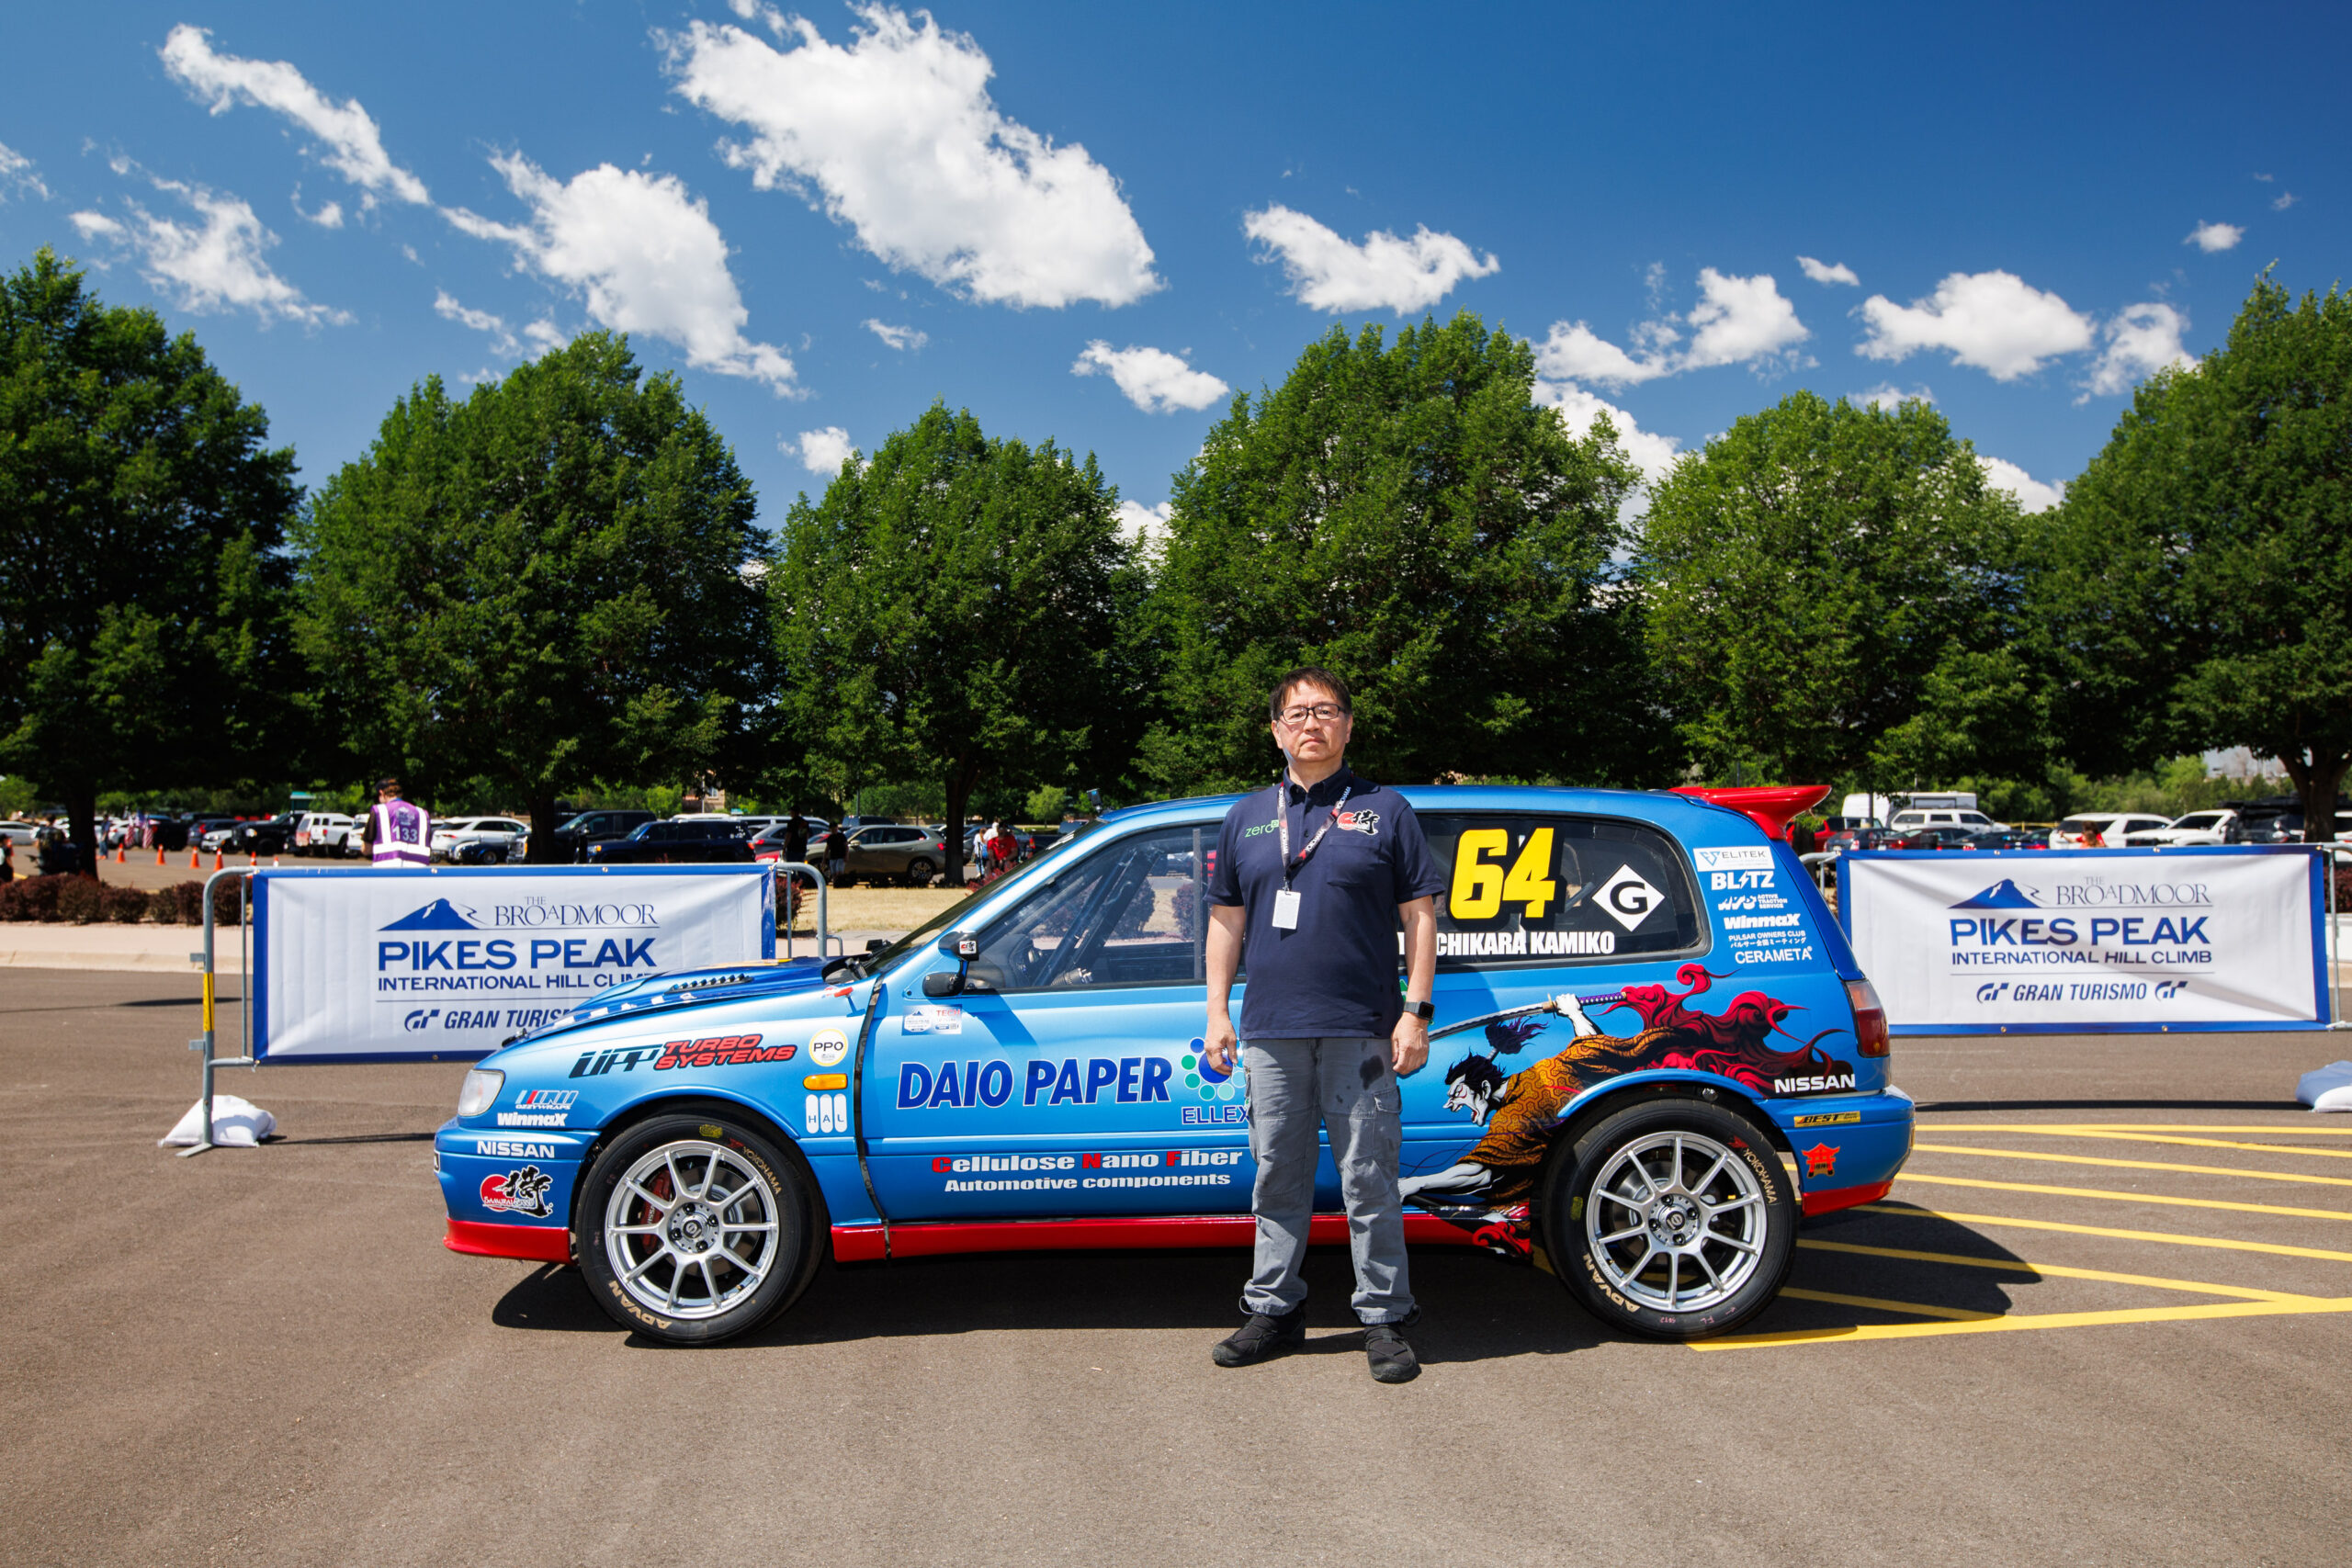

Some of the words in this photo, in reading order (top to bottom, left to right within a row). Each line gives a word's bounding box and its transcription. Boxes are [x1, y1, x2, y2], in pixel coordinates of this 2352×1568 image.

[392, 825, 418, 842] 133
[1721, 851, 1766, 859] ELITEK
[1449, 828, 1556, 919] 64
[1711, 870, 1775, 890] BLITZ
[2085, 876, 2105, 885] THE
[524, 897, 547, 905] THE
[1610, 880, 1648, 915] G
[2056, 884, 2211, 905] BROADMOOR
[495, 904, 658, 926] BROADMOOR
[1728, 933, 1756, 942] PULSAR
[1757, 931, 1786, 939] OWNERS
[1950, 918, 2078, 946] PIKES
[2091, 917, 2211, 945] PEAK
[1436, 931, 1527, 956] CHIKARA
[1531, 931, 1615, 955] KAMIKO
[379, 940, 517, 971] PIKES
[530, 938, 657, 969] PEAK
[1952, 951, 2098, 964] INTERNATIONAL
[2105, 951, 2146, 964] HILL
[2151, 950, 2211, 964] CLIMB
[379, 975, 540, 991] INTERNATIONAL
[547, 974, 589, 988] HILL
[594, 973, 652, 987] CLI
[2013, 985, 2064, 1001] GRAN
[2070, 983, 2147, 1001] TURISMO
[445, 1010, 500, 1029] GRAN
[506, 1009, 571, 1028] TURIS
[936, 1009, 961, 1017] TECH
[663, 1033, 763, 1055] TURBO
[813, 1042, 844, 1052] PPO
[653, 1044, 797, 1071] SYSTEMS
[896, 1059, 1014, 1110] DAIO
[1023, 1056, 1173, 1107] PAPER
[1774, 1074, 1856, 1094] NISSAN
[1804, 1112, 1842, 1123] BEST
[477, 1140, 555, 1158] NISSAN
[743, 1146, 782, 1194] YOKOHAMA
[932, 1154, 1075, 1174] Cellulose
[1082, 1152, 1159, 1170] Nano
[1166, 1150, 1243, 1168] Fiber
[944, 1177, 1078, 1192] Automotive
[1082, 1173, 1231, 1190] components
[1744, 1148, 1778, 1204] YOKOHAMA
[1583, 1253, 1640, 1313] ADVAN
[608, 1280, 673, 1329] ADVAN
